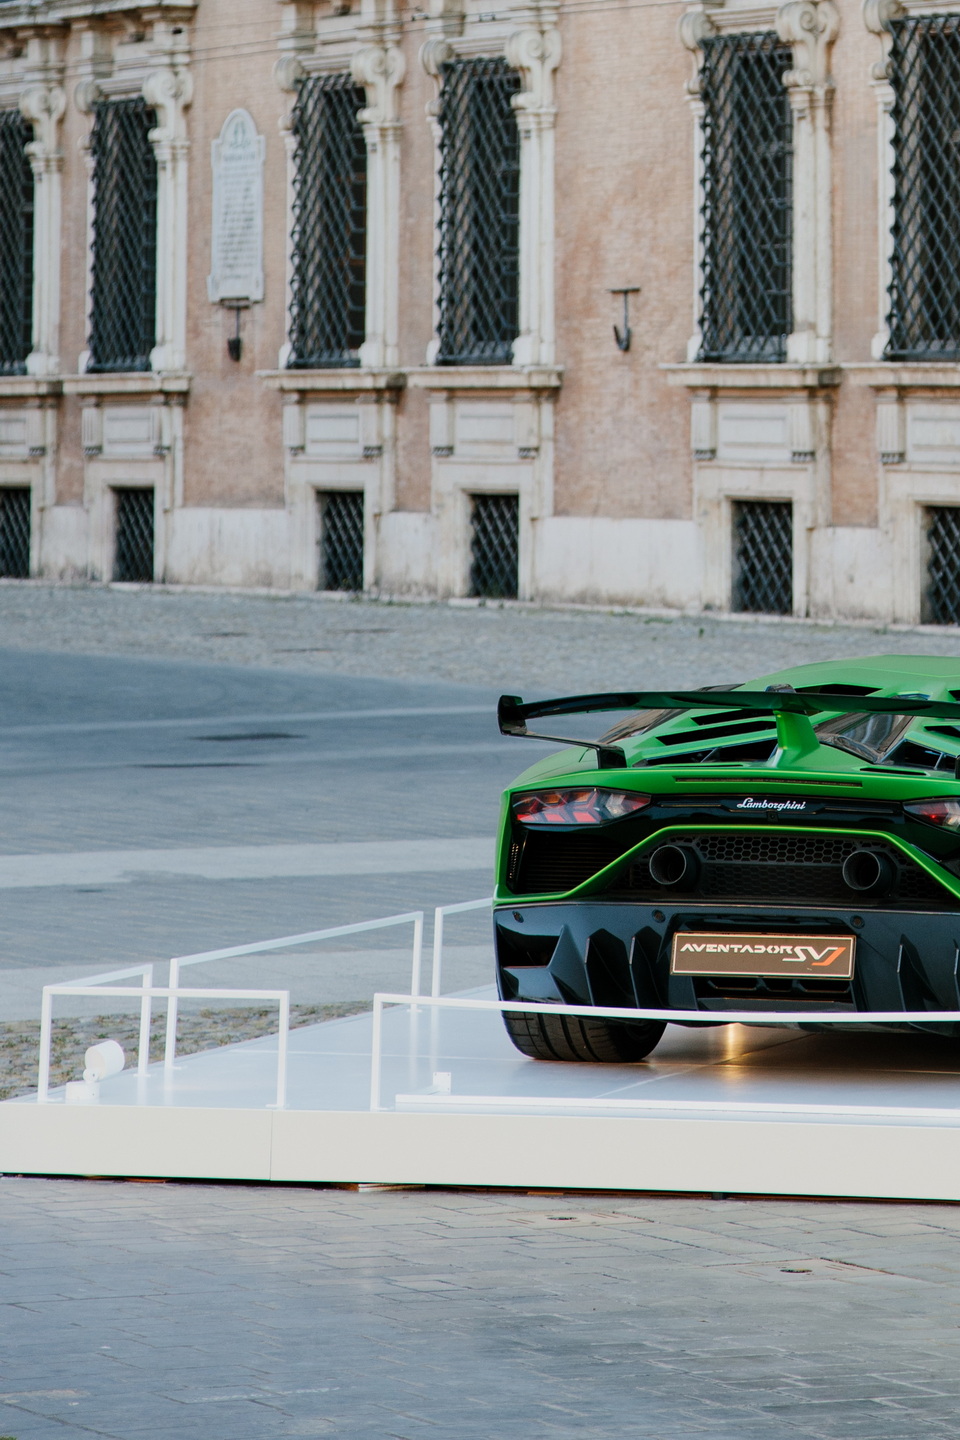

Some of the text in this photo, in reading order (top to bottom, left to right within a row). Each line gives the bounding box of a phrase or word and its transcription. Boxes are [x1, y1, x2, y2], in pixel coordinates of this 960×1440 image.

[737, 797, 806, 811] Lamborghini
[680, 943, 846, 966] AVENTADOR SVJ
